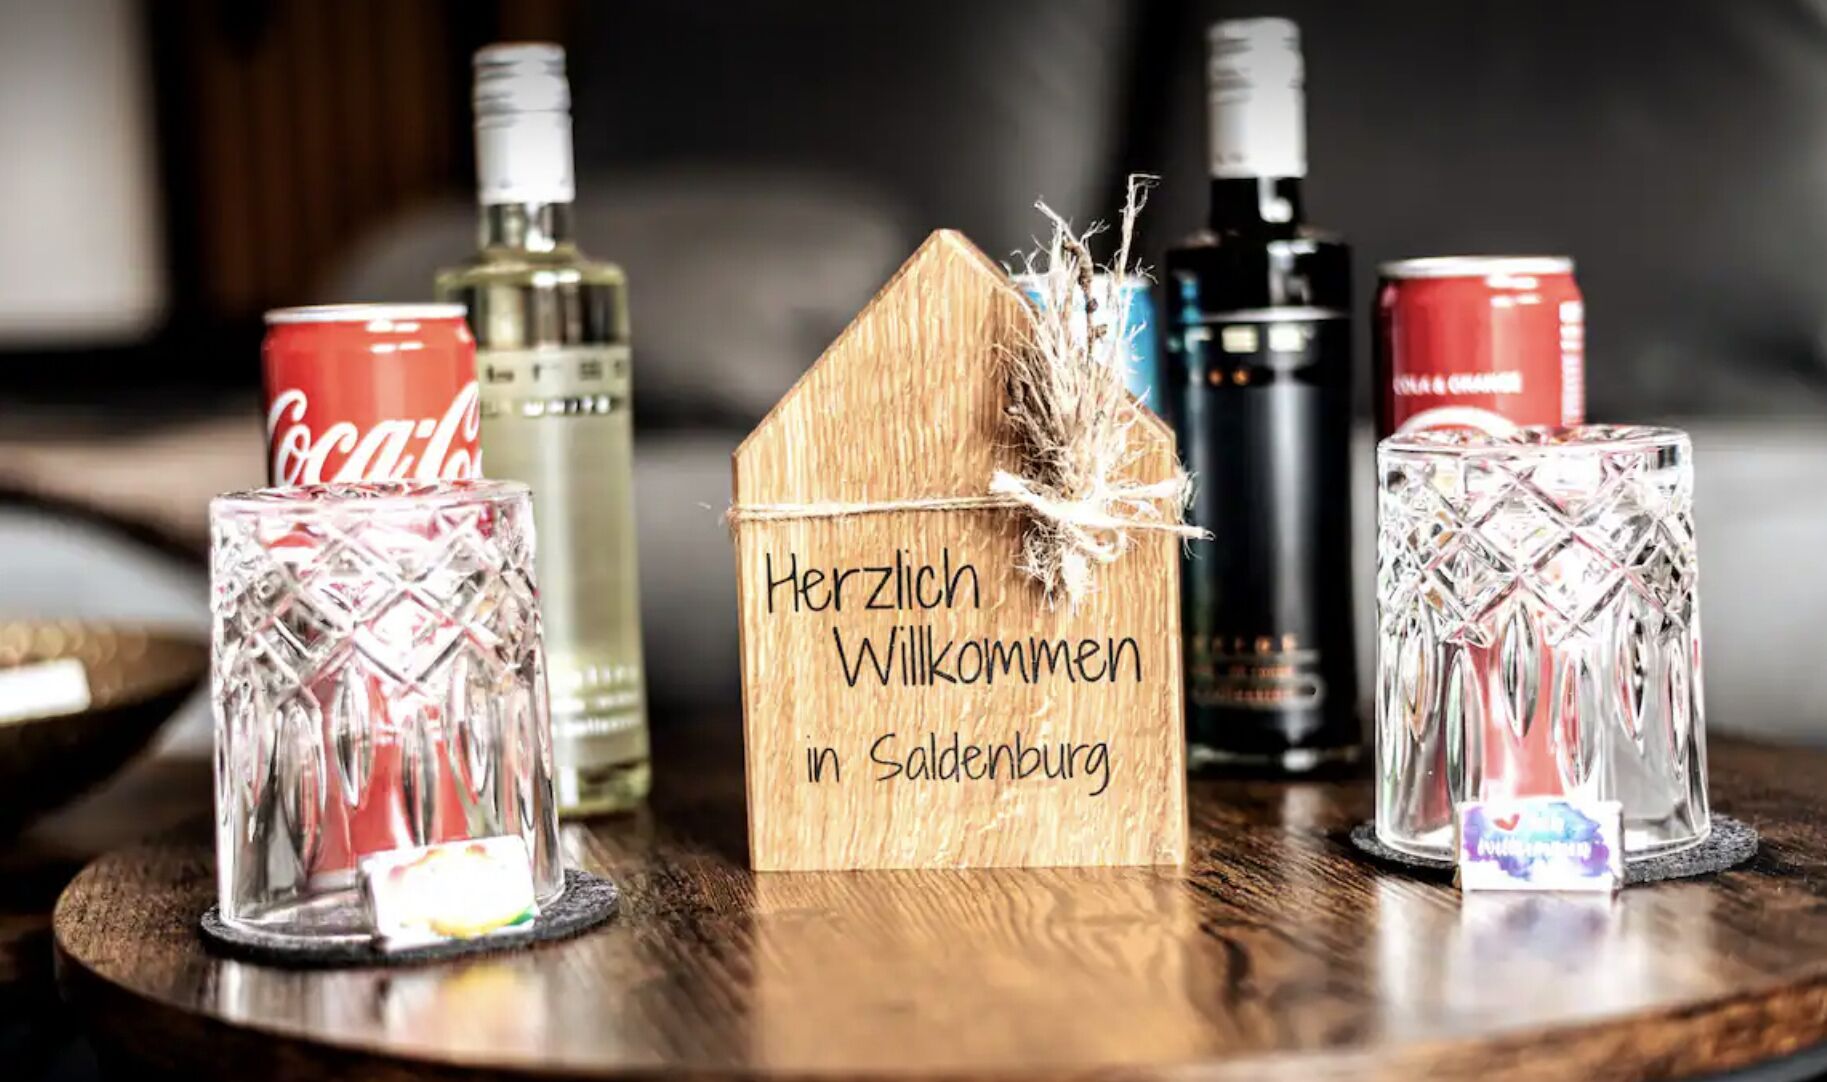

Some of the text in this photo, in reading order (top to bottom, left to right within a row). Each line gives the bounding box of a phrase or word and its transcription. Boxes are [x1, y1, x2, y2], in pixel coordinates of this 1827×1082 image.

[765, 547, 980, 613] Herzlich
[832, 625, 1142, 687] Willkommen
[806, 731, 1111, 796] in Saldenburg
